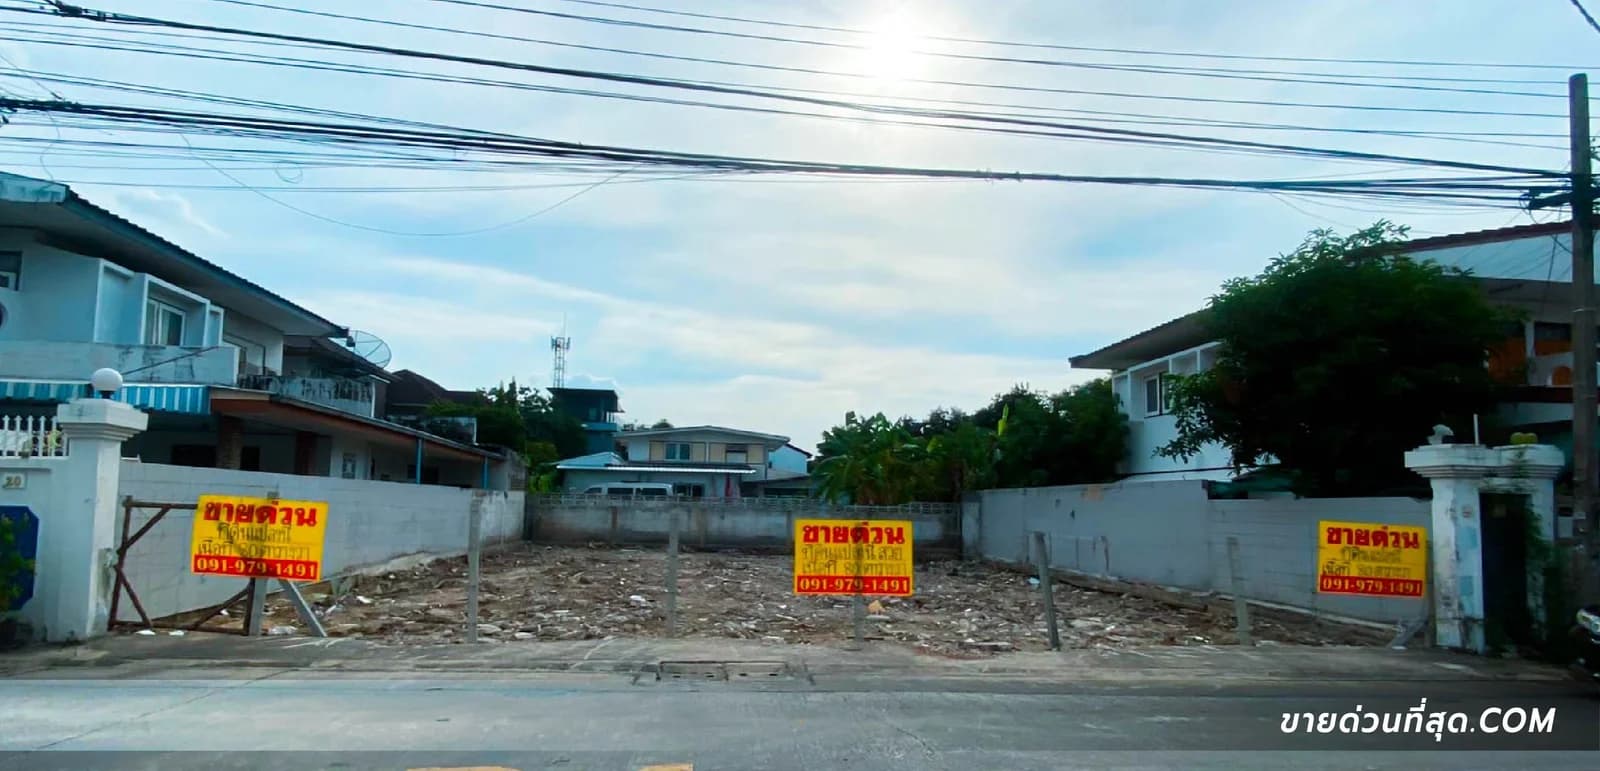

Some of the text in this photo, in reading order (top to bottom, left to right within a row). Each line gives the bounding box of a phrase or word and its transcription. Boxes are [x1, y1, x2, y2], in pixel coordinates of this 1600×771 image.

[204, 499, 317, 527] ขายด่วน
[803, 521, 905, 545] ขายด่วน
[1326, 525, 1420, 549] ขายด่วน
[197, 559, 317, 577] 091-979-1491
[800, 578, 909, 593] 091-979-1491
